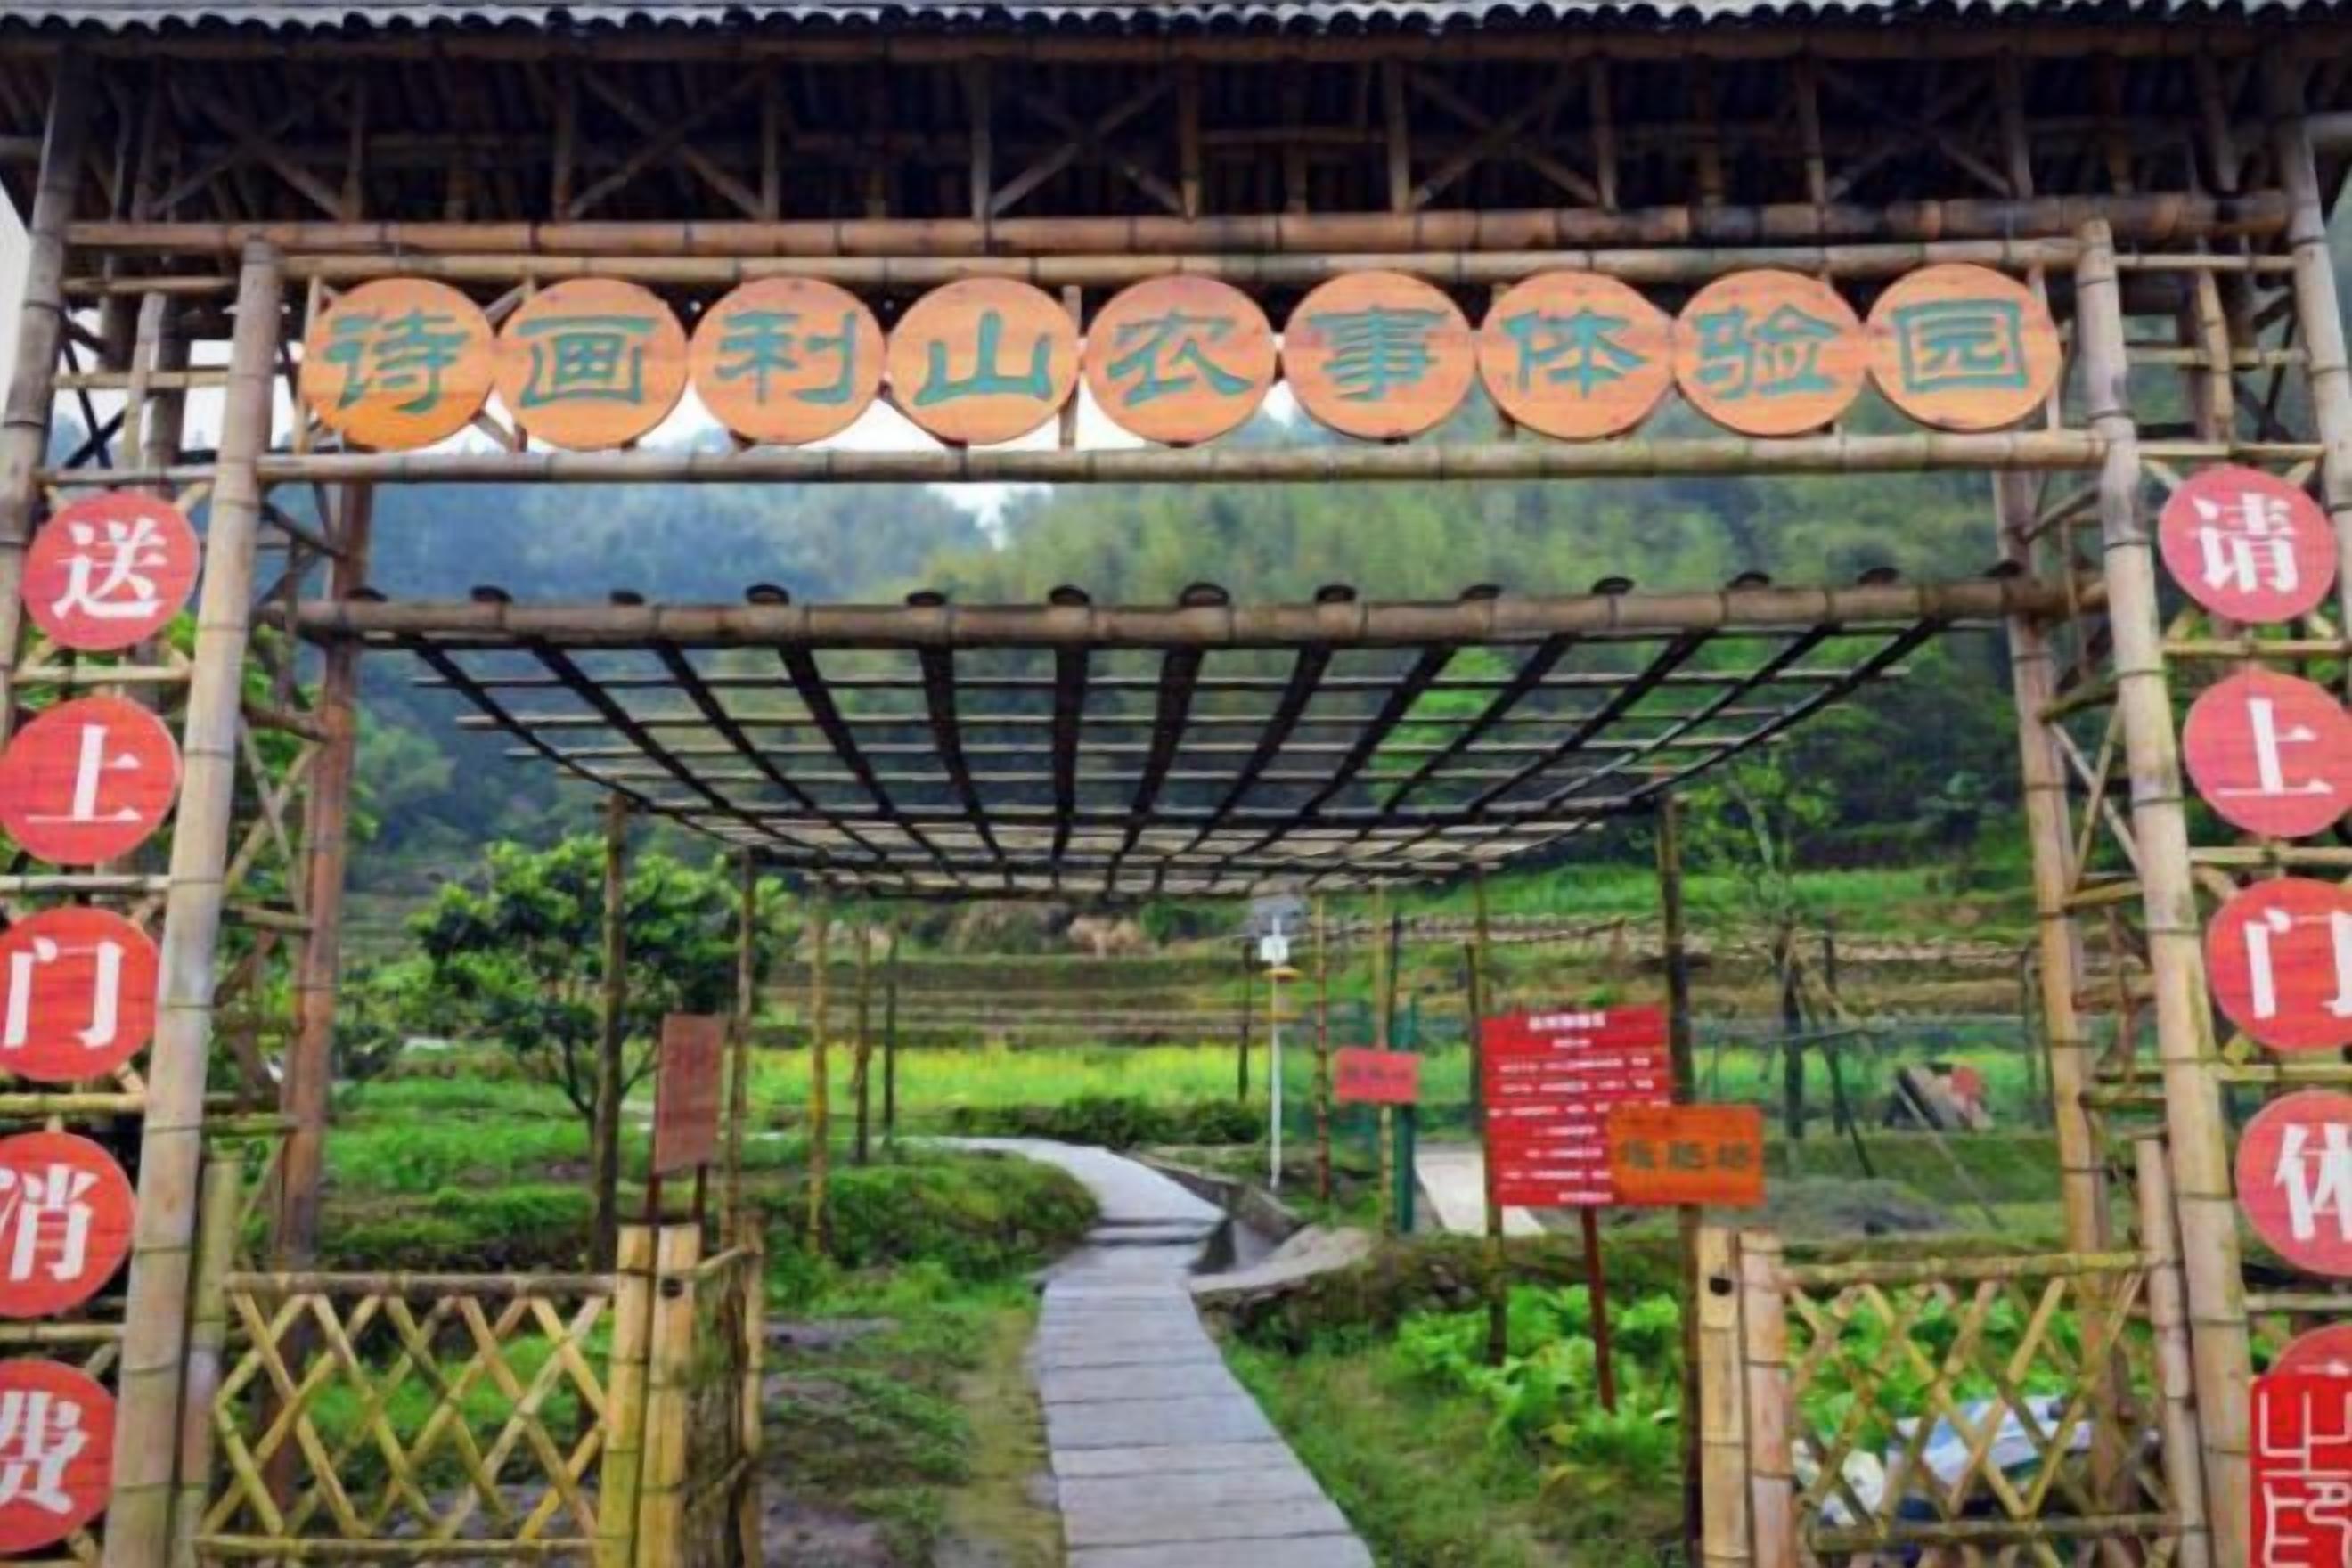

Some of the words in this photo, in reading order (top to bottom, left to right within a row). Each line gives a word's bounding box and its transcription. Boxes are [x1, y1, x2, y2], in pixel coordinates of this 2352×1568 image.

[323, 299, 2029, 413] 诗画利山农事体验园
[2187, 490, 2352, 1377] 请上门休
